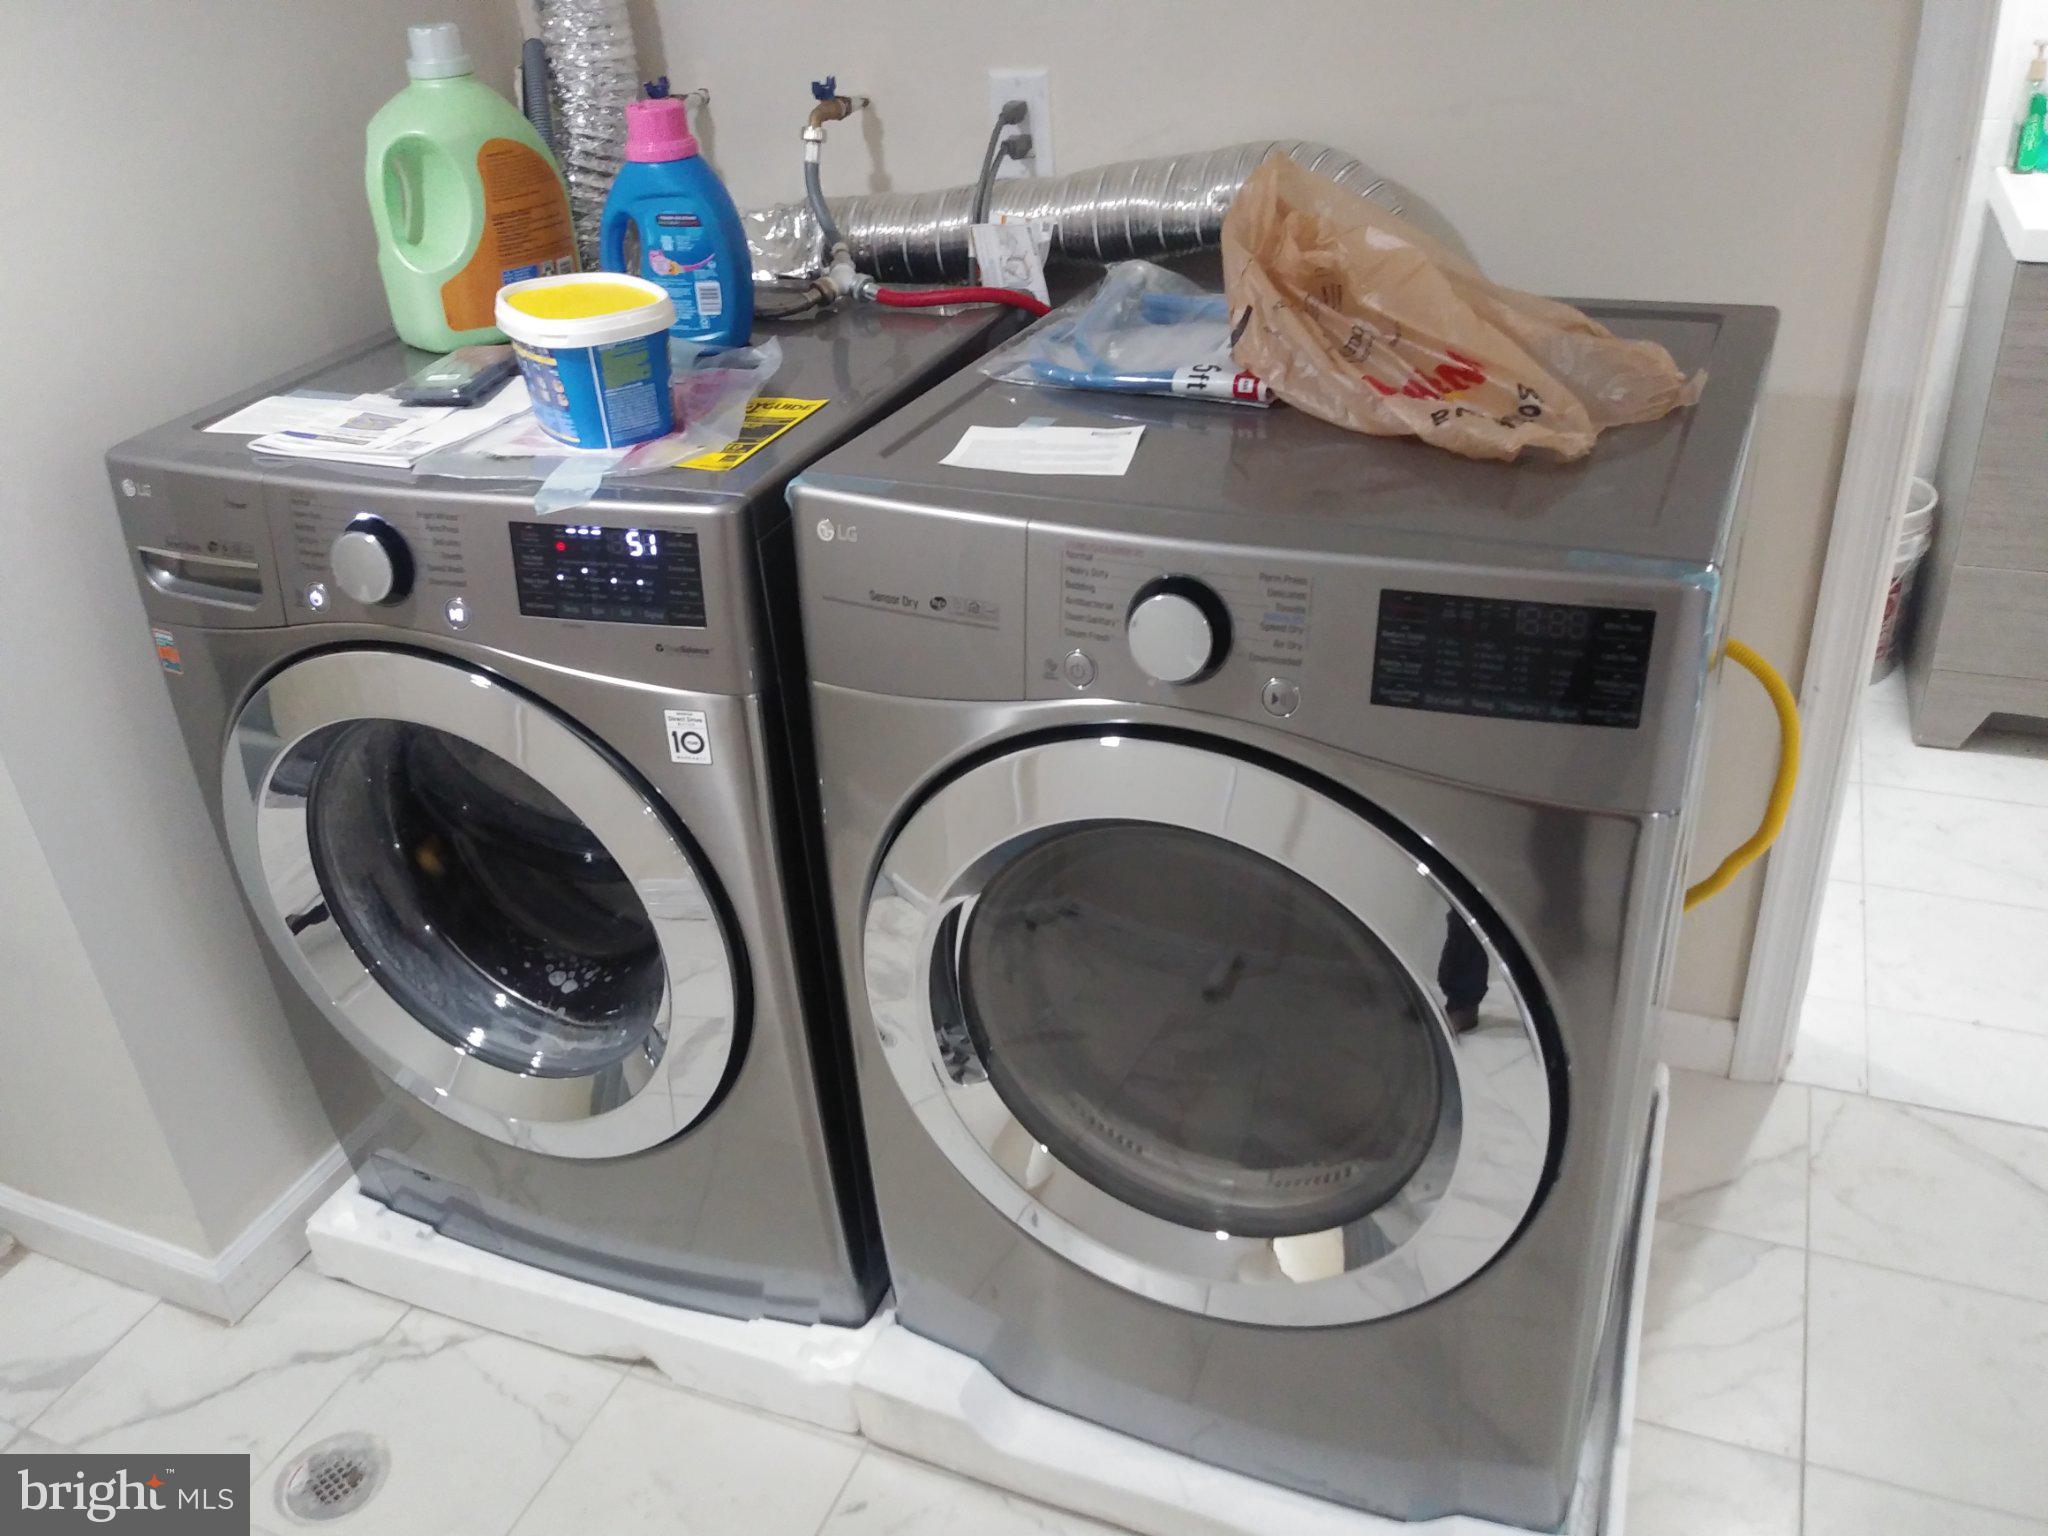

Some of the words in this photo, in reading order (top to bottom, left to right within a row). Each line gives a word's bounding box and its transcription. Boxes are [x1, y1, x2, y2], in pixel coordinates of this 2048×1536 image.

[1187, 364, 1222, 390] 5ft
[626, 529, 656, 558] 51
[837, 523, 858, 542] LG
[868, 589, 900, 605] Sensor
[901, 595, 919, 610] Dry
[672, 730, 705, 754] 10
